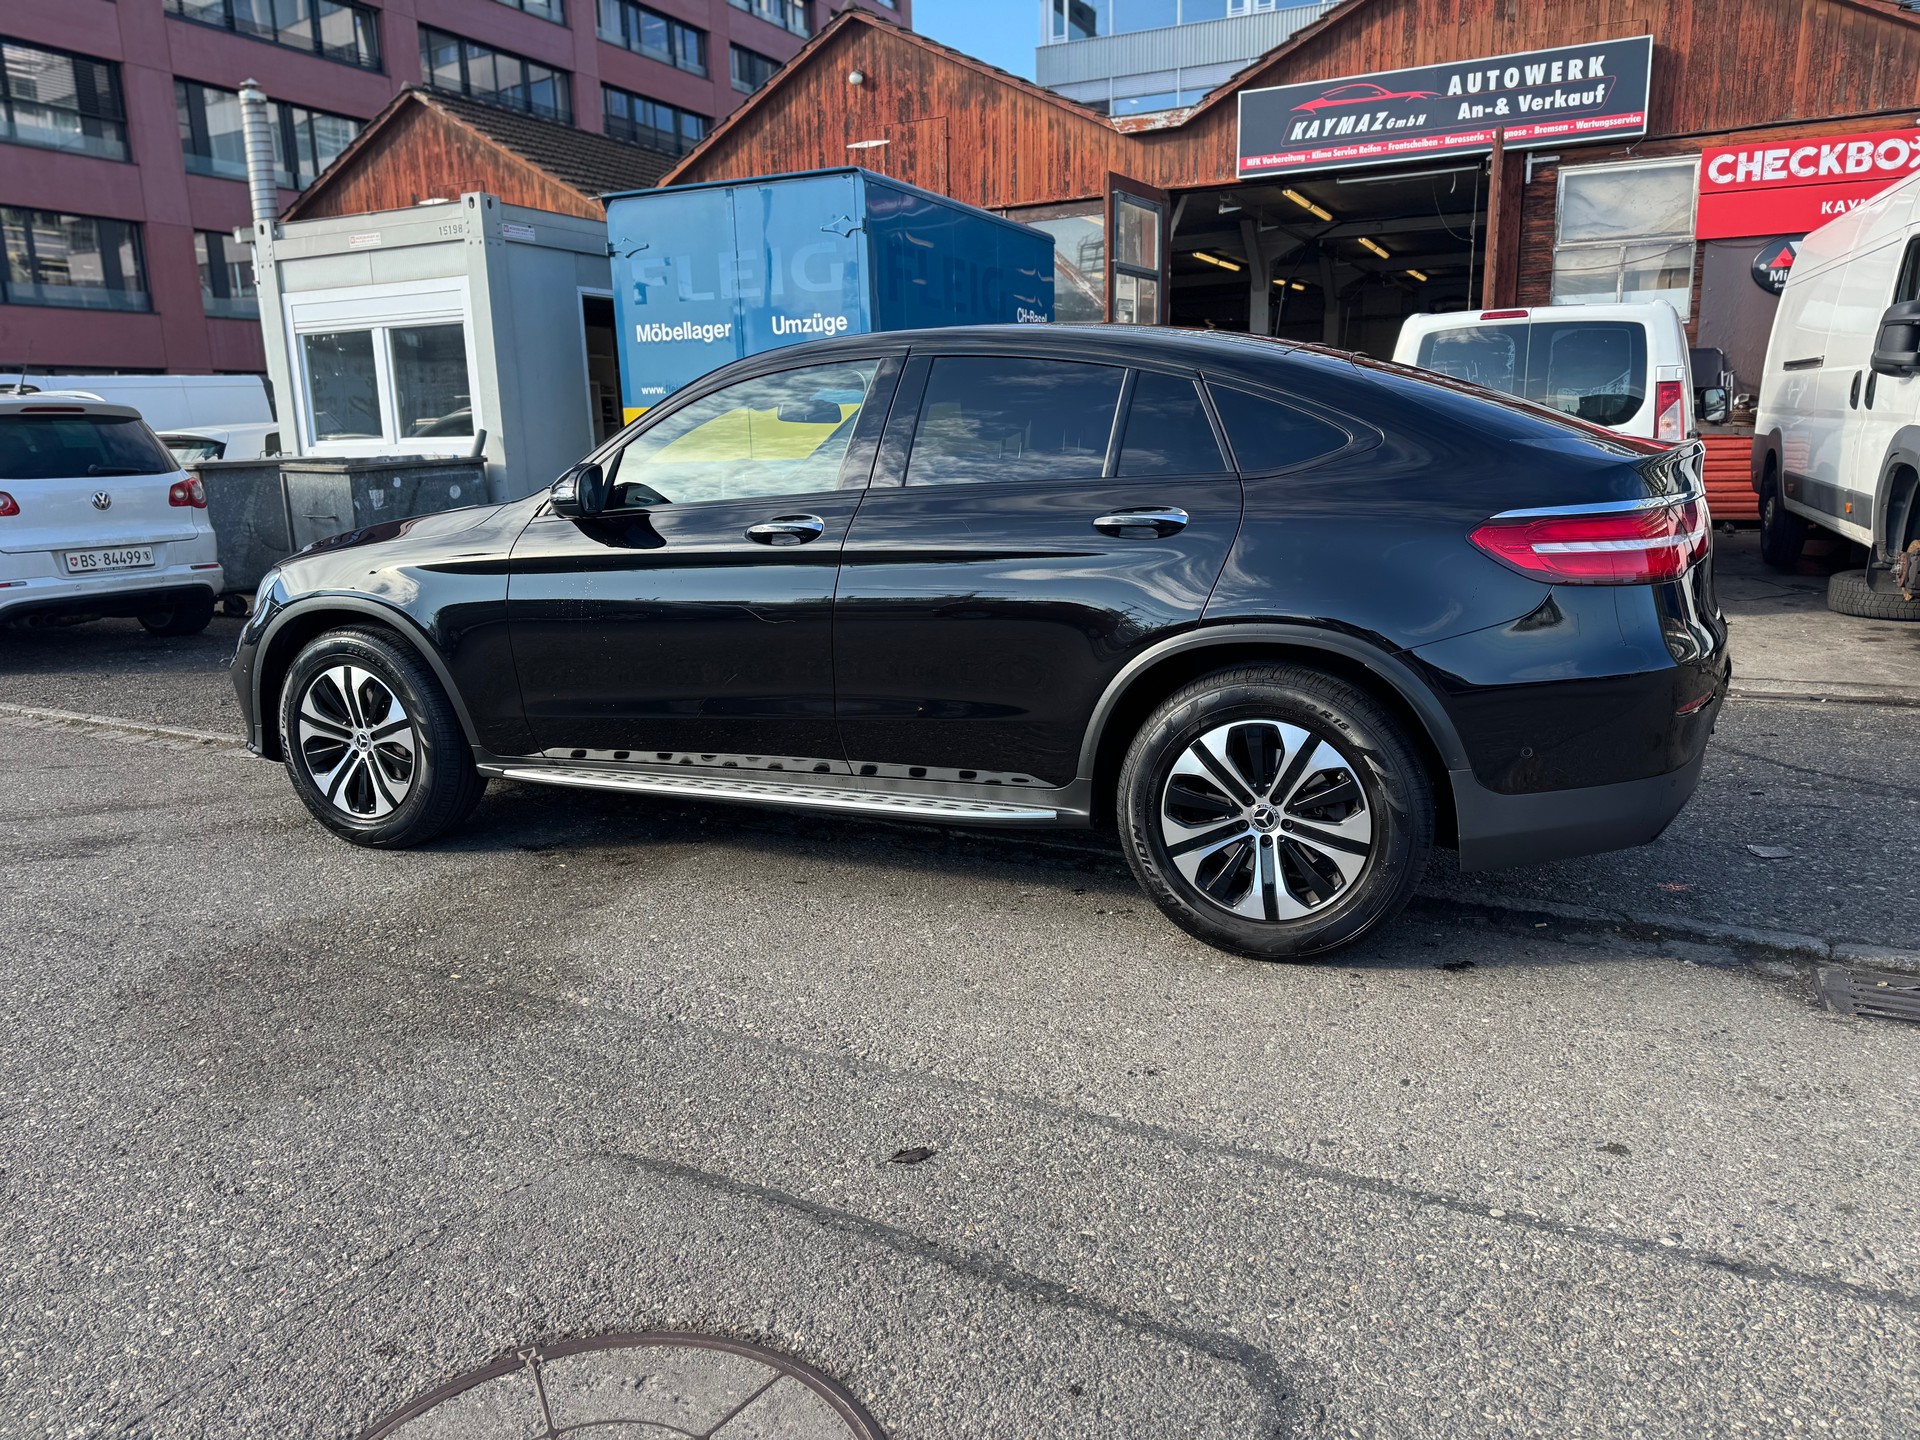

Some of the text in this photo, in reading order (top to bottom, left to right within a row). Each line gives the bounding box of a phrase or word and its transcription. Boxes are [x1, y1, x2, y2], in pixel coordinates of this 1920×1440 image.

[1447, 55, 1605, 96] AUTOWERK
[1518, 84, 1605, 112] Verkauf
[1262, 153, 1306, 165] Vorbereitung
[1311, 150, 1332, 159] Klima
[1333, 147, 1358, 157] Service
[1359, 144, 1381, 154] Reifen
[1388, 138, 1438, 151] Frontscheiben
[1445, 132, 1484, 144] Karosserie
[1534, 123, 1568, 134] Bremsen
[1576, 114, 1642, 129] Wartungsservice
[1290, 111, 1427, 140] KAYMAZ GmbH
[439, 224, 463, 235] 15198
[636, 313, 848, 343] Möbellager Umzüge
